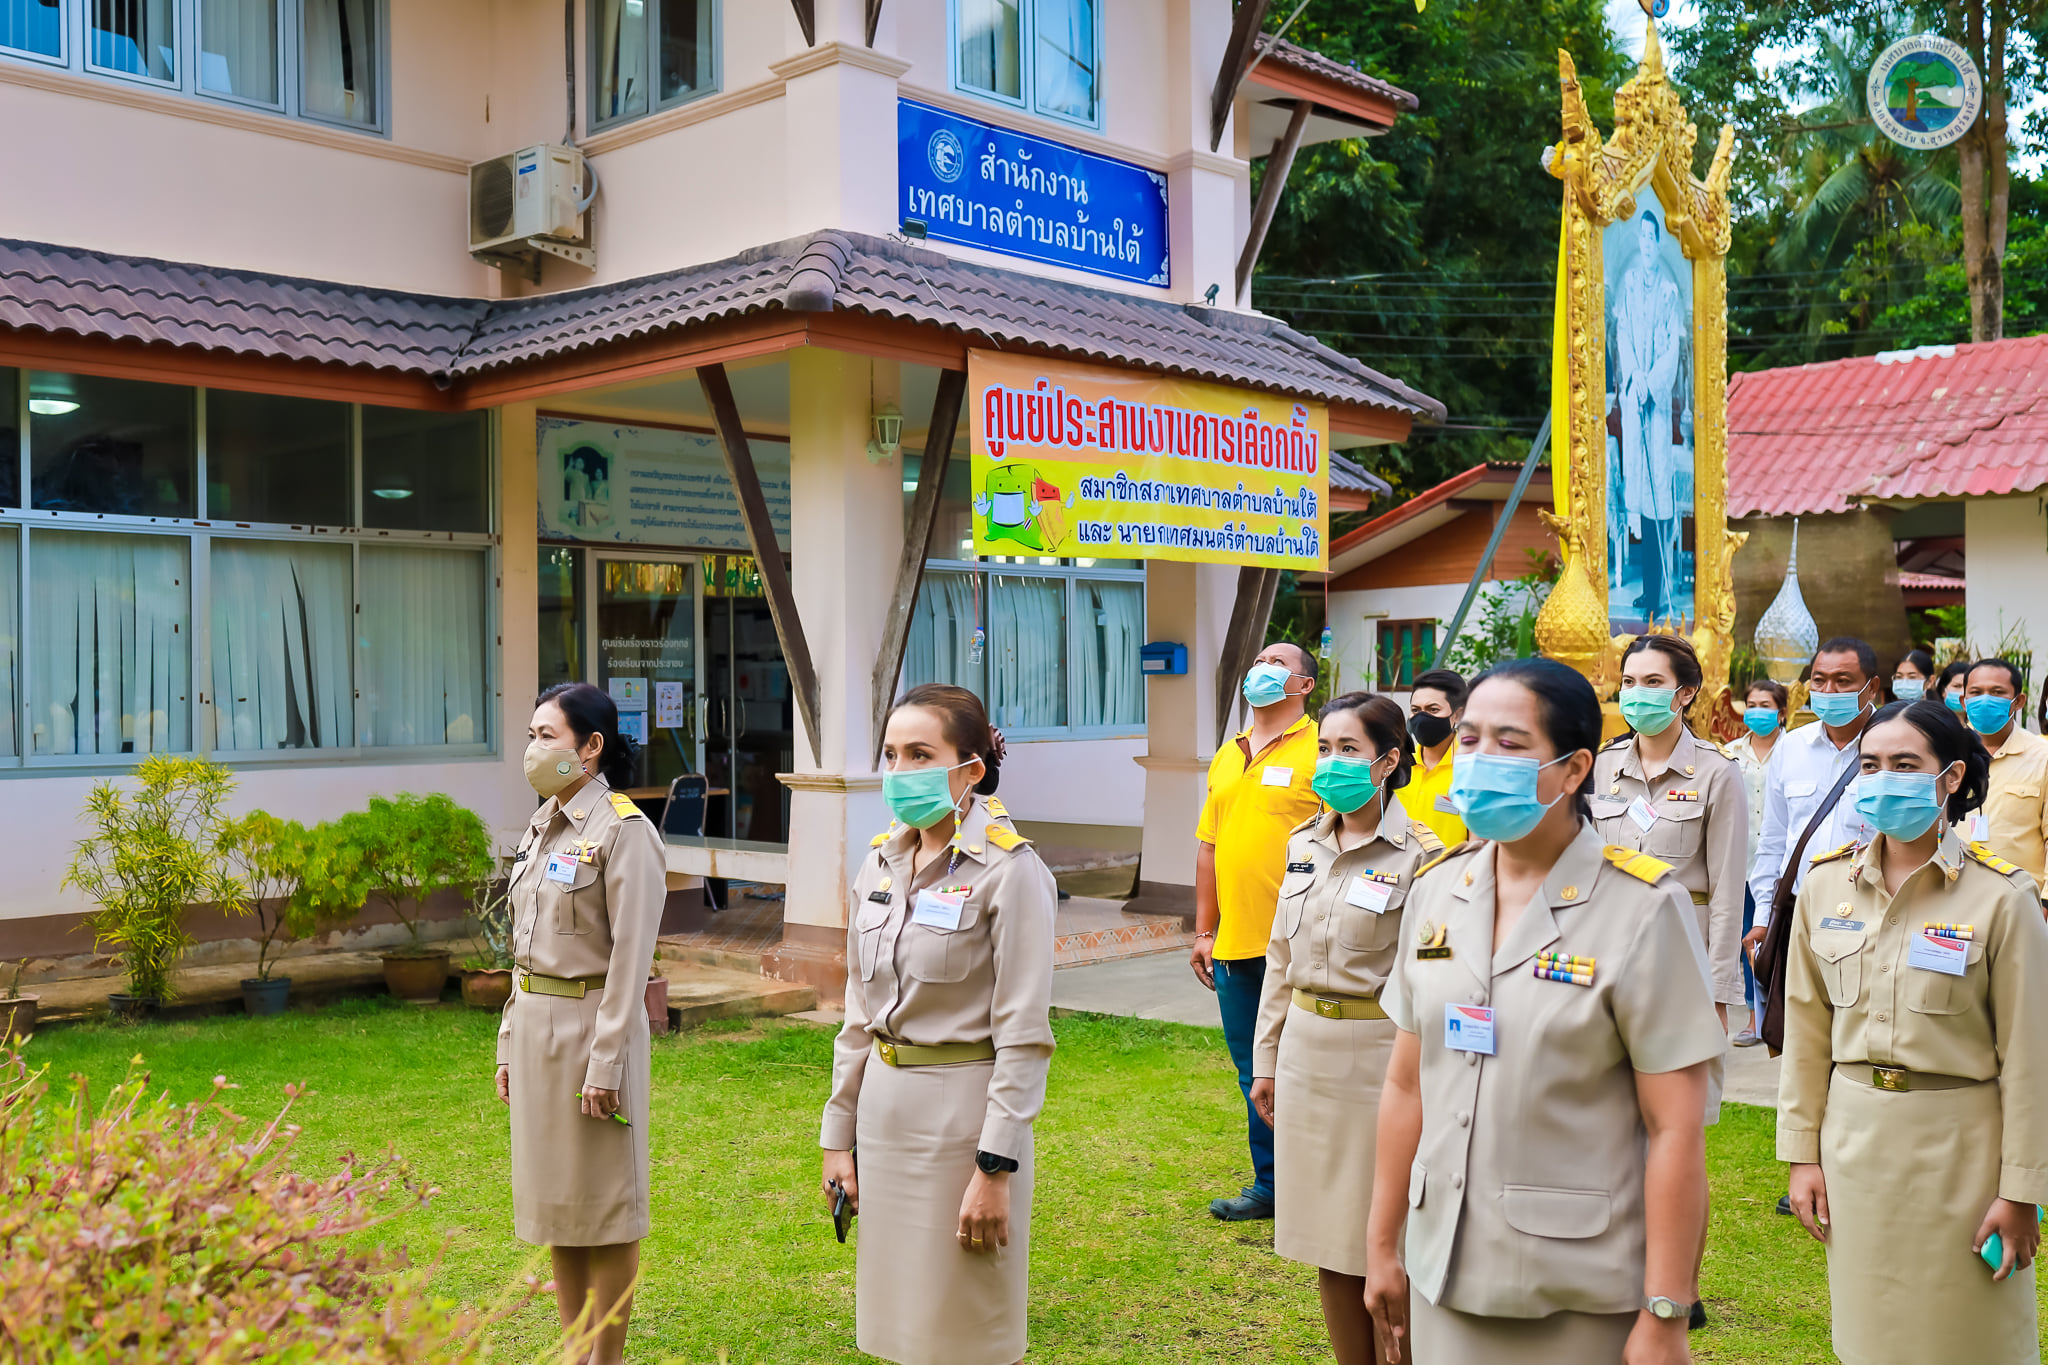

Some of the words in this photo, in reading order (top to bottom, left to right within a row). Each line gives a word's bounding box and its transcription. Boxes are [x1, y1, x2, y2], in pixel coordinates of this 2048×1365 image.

[980, 142, 1089, 205] สำนักงาน
[908, 185, 1144, 264] เทศบาลตำบลบ้านใต้
[984, 378, 1319, 475] ศูนย์ประสานงานการเลือกตั้ง
[1079, 472, 1318, 520] สมาชิกสภาเทศบาลตำบลบ้านใต้
[1078, 520, 1113, 544] และ
